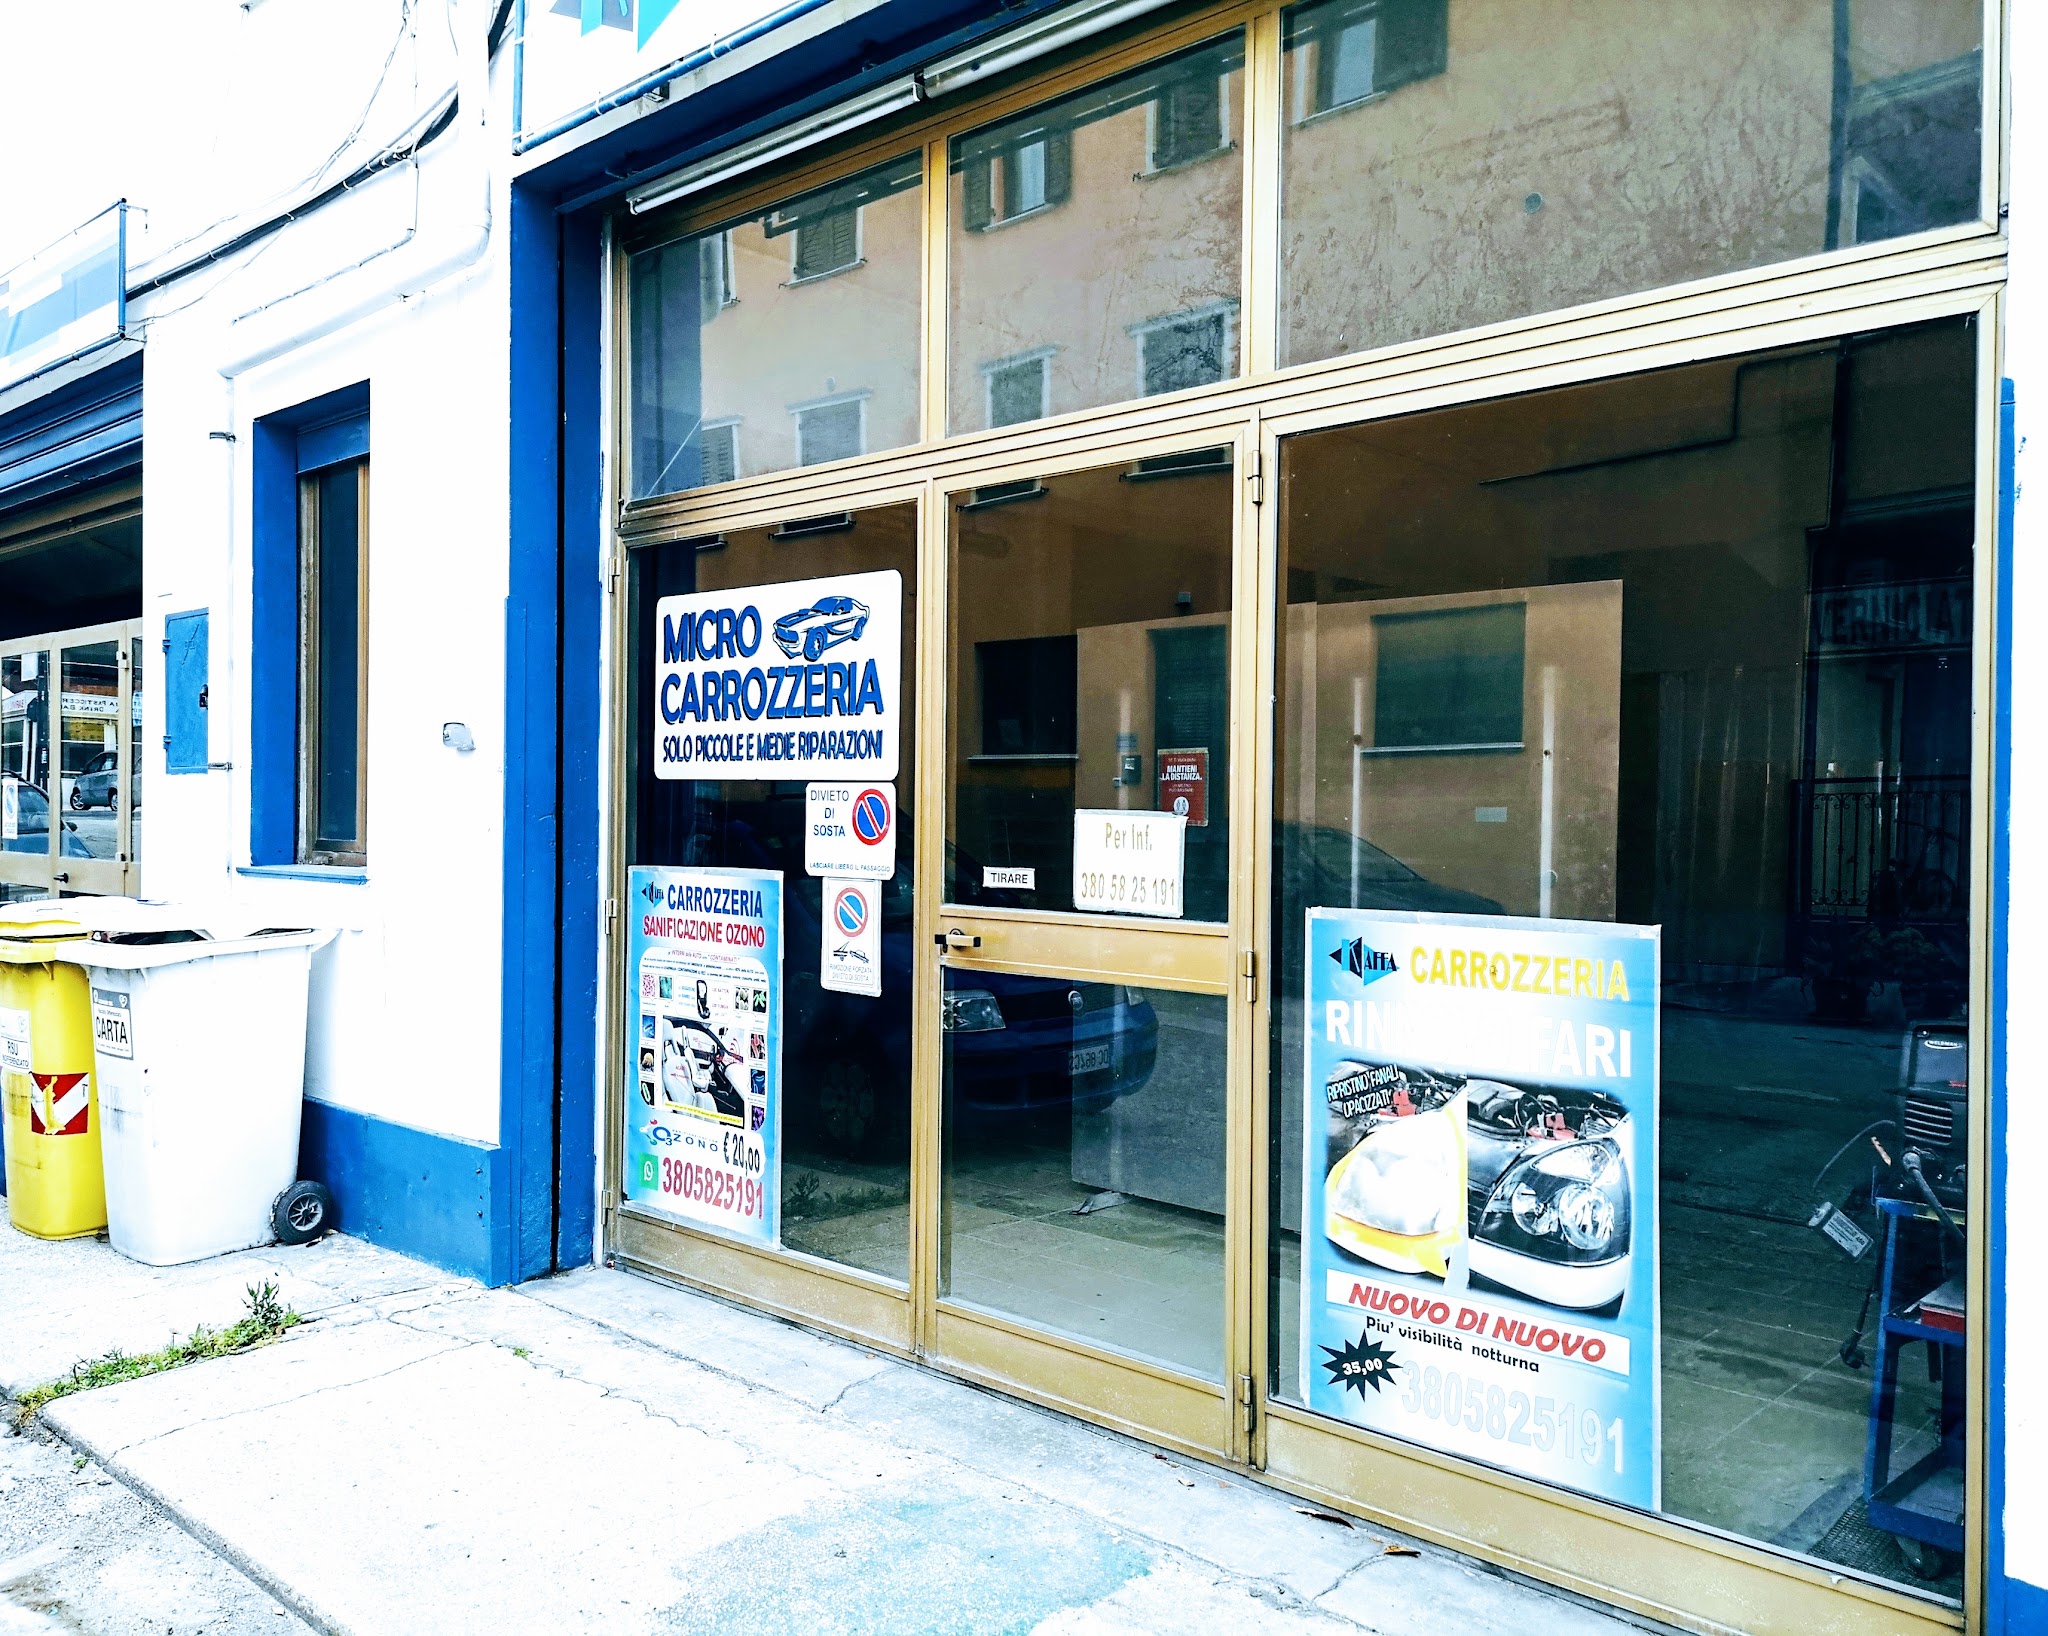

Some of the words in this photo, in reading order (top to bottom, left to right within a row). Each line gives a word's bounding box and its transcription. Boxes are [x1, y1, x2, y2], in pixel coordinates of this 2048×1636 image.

[663, 605, 762, 663] MICRO
[661, 658, 884, 725] CARROZZERIA
[663, 735, 693, 763] SOLO
[695, 732, 744, 762] PICCOLE
[746, 733, 754, 761] E
[757, 731, 795, 761] MEDIE
[798, 729, 883, 761] RIPARAZIONI
[1162, 773, 1170, 781] LA
[1166, 765, 1198, 773] MANTIENI
[810, 789, 850, 802] DIVIETO
[824, 807, 835, 819] DI
[813, 824, 846, 837] SOSTA
[1105, 822, 1126, 850] Per
[809, 862, 834, 870] LASCIARE
[835, 863, 854, 871] LIBERO
[860, 864, 891, 873] PASSAGGIO
[990, 872, 1028, 884] TIRARE
[668, 884, 763, 919] CARROZZERIA
[1081, 872, 1105, 899] 380
[1109, 874, 1126, 901] 58
[1132, 876, 1146, 903] 25
[1153, 878, 1175, 906] 191
[643, 915, 723, 943] SANIFICAZIONE
[726, 923, 765, 948] OZONO
[1410, 945, 1630, 1002] CARROZZERIA
[95, 1016, 128, 1045] CARTA
[1528, 1015, 1631, 1077] FARI
[723, 1131, 730, 1164] €
[662, 1157, 763, 1220] 3805825191
[1348, 1283, 1450, 1325] NUOVO
[1455, 1308, 1489, 1335] DI
[1492, 1316, 1606, 1363] NUOVO
[1399, 1326, 1463, 1351] visibilità
[1472, 1345, 1540, 1373] notturna
[1342, 1357, 1383, 1376] 35,00
[1401, 1360, 1624, 1473] 3805825191
